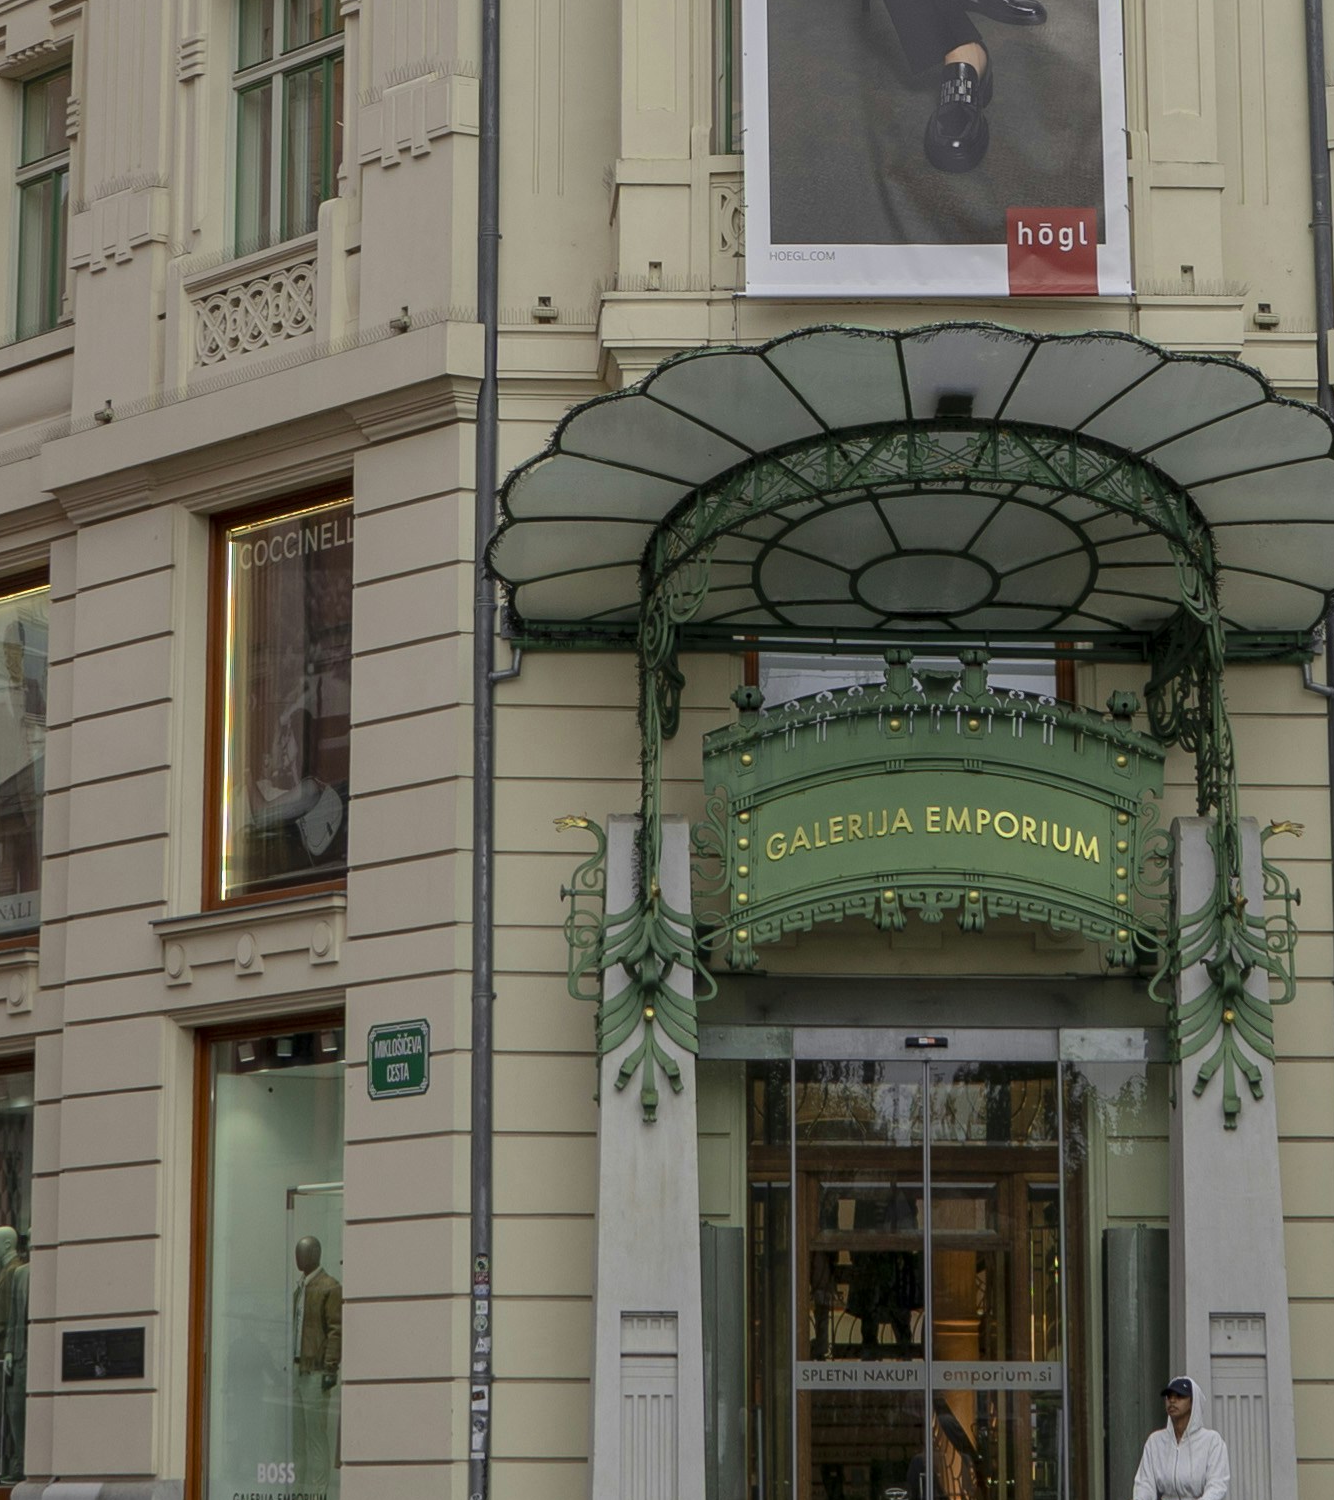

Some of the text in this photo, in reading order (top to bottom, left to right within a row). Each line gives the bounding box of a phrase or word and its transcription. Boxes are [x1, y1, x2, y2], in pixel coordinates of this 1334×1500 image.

[769, 250, 836, 262] HOEGL.COM
[765, 806, 1101, 864] GALERIJA EMPORIUM
[374, 1032, 423, 1059] MIKLOŠIČEVA
[387, 1062, 410, 1083] CESTA
[802, 1369, 919, 1382] SPLETNI NAKUPI
[943, 1366, 1052, 1385] emporium.si
[257, 1462, 296, 1484] BOSS
